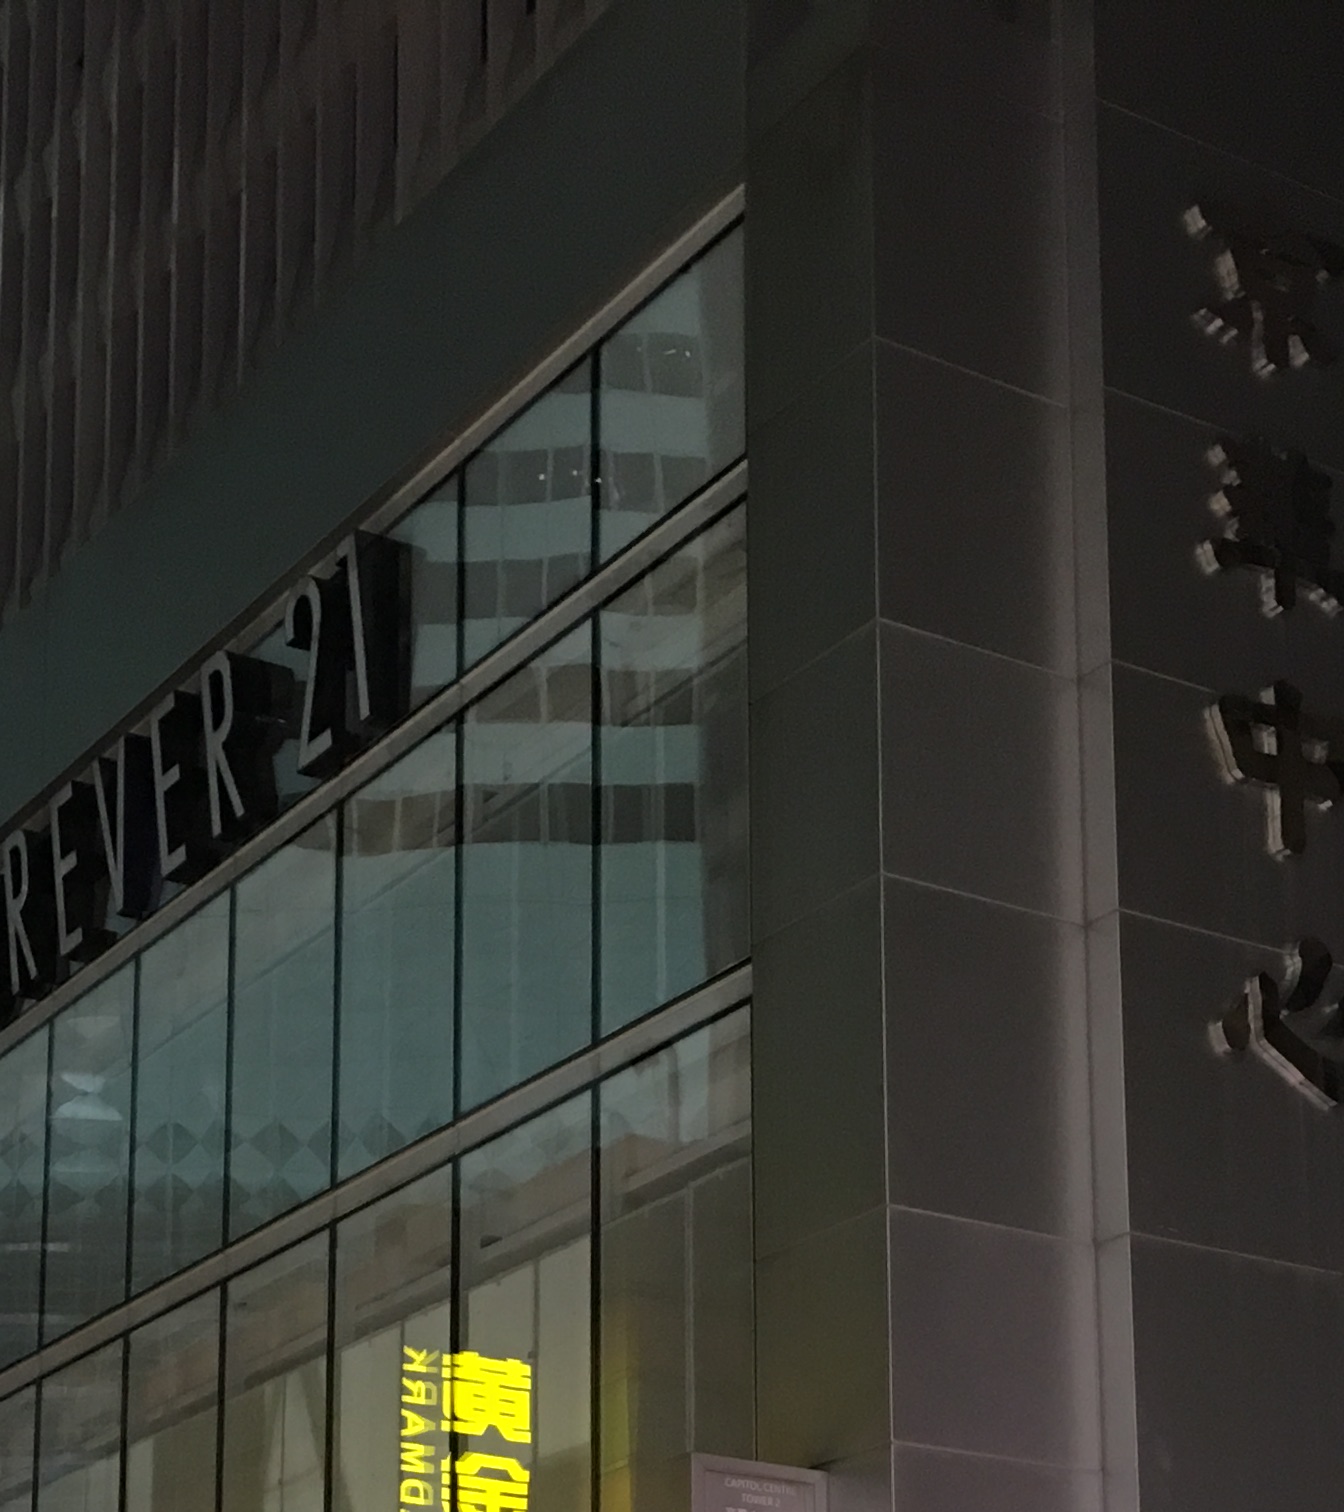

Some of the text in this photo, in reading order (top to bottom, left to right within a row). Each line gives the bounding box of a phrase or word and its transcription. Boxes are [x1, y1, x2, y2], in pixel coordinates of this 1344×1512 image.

[285, 530, 382, 775] 21
[724, 1476, 761, 1491] CAPITOL
[741, 1493, 774, 1506] TOWER
